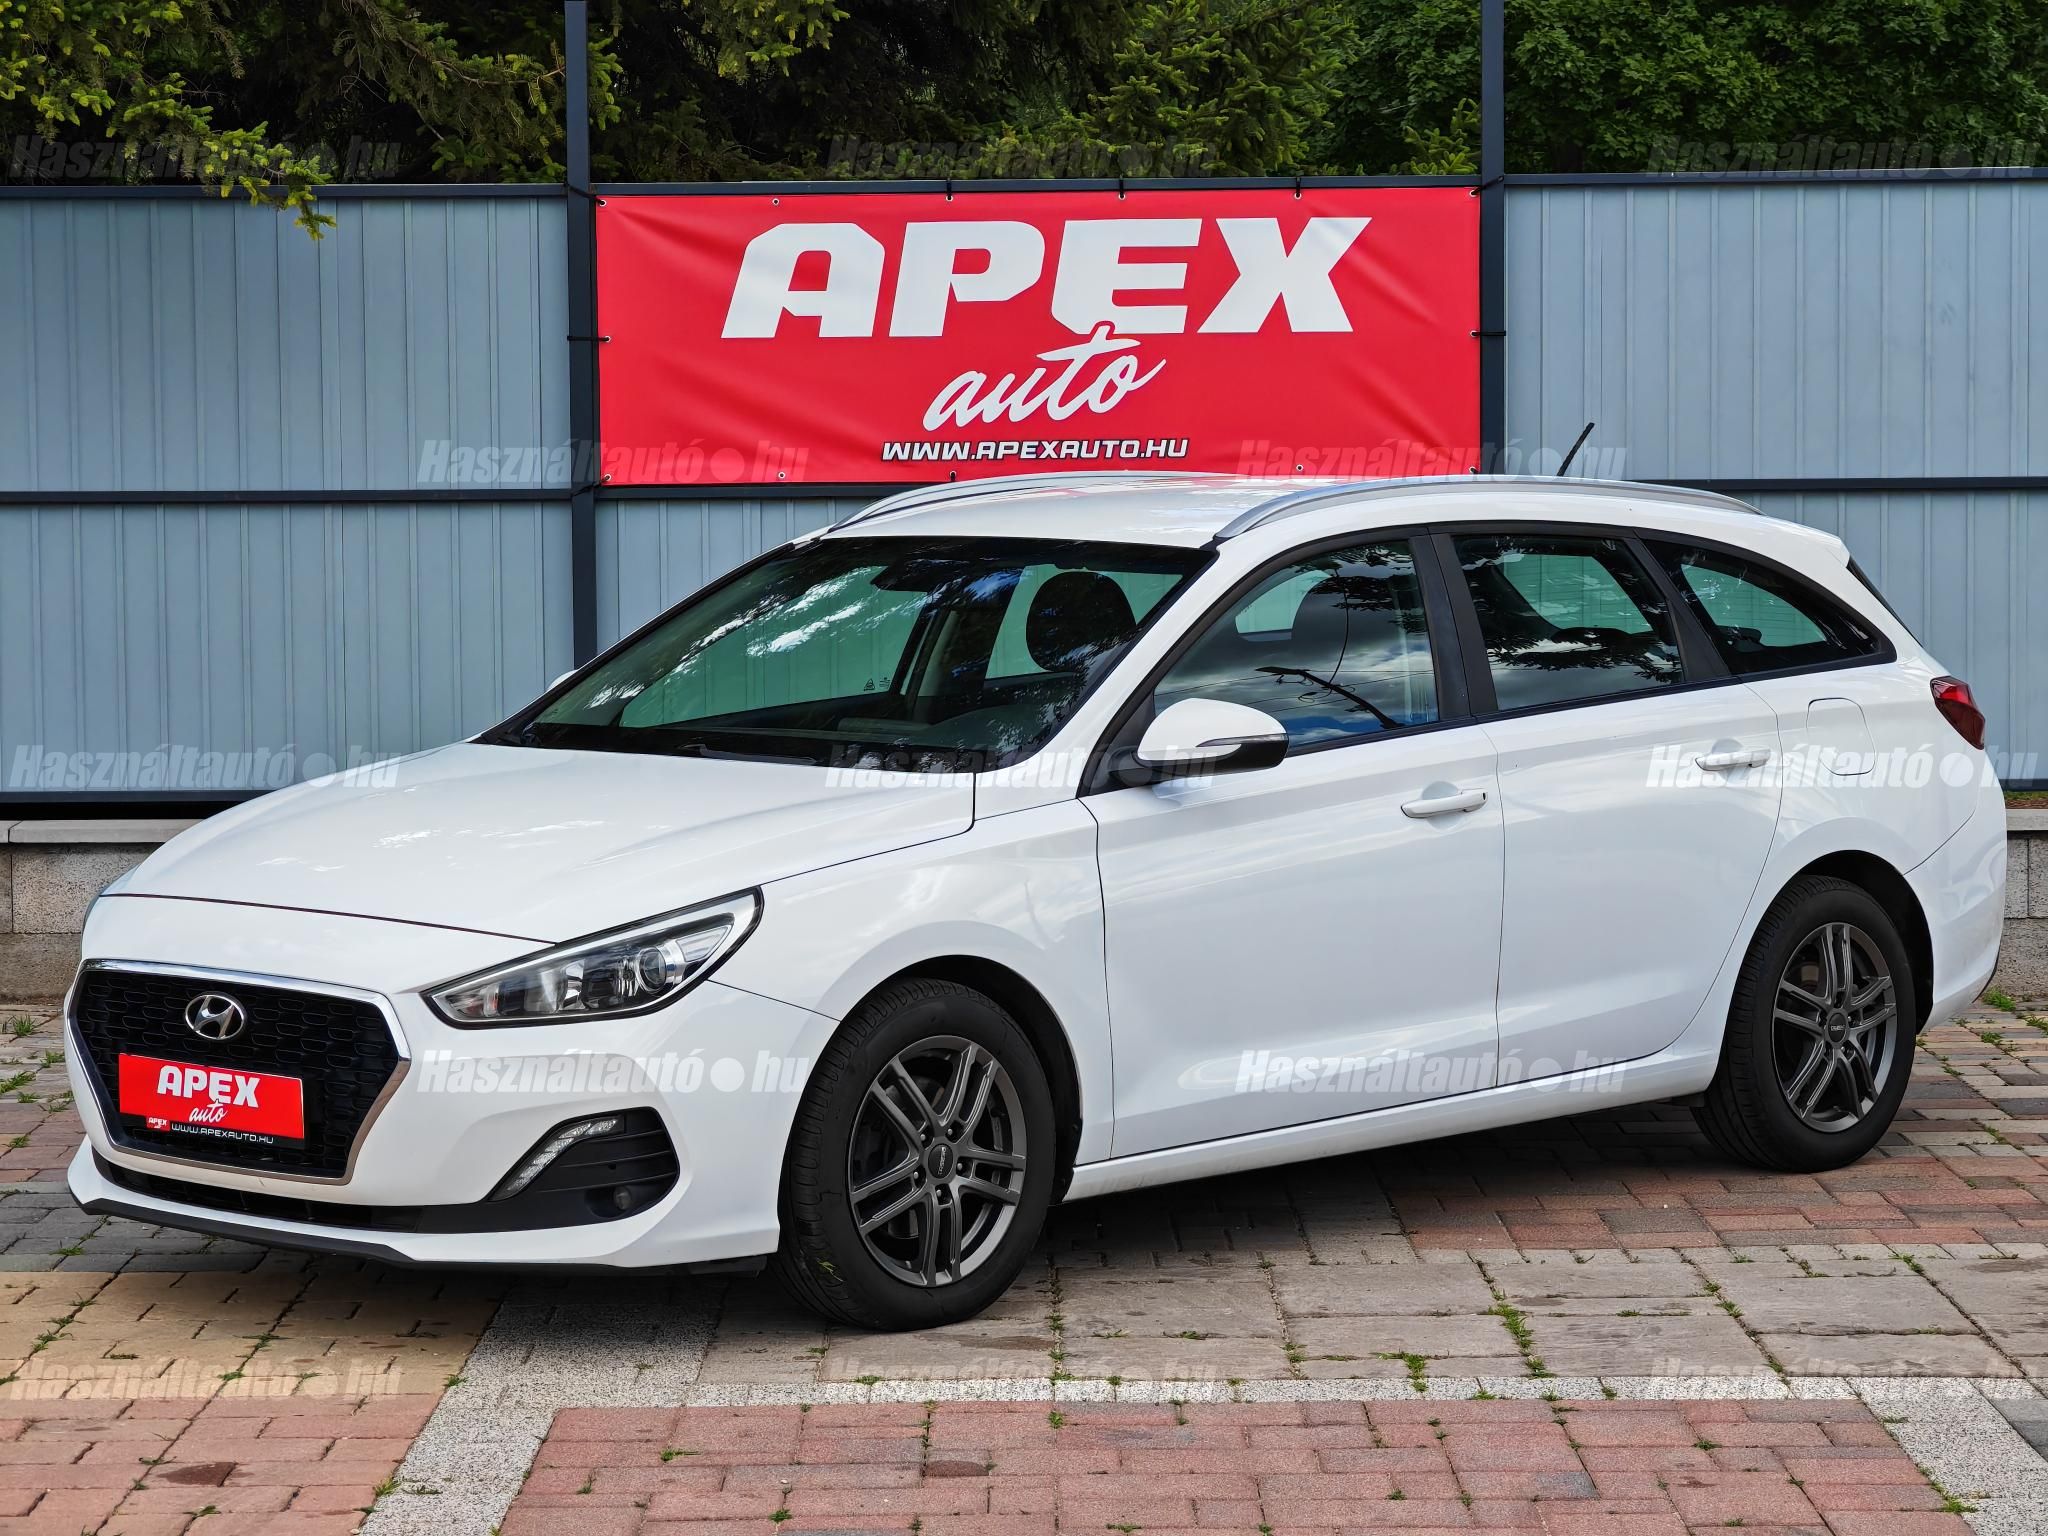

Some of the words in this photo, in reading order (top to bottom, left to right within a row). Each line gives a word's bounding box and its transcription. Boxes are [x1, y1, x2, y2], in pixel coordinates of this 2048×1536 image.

[721, 217, 1373, 338] APEX
[922, 325, 1167, 432] auto
[881, 438, 1190, 462] WWW.APEXAUTO.HU
[157, 1065, 260, 1108] APEX
[188, 1099, 229, 1123] auto
[171, 1123, 274, 1144] WWW.APEXAUTO.HU
